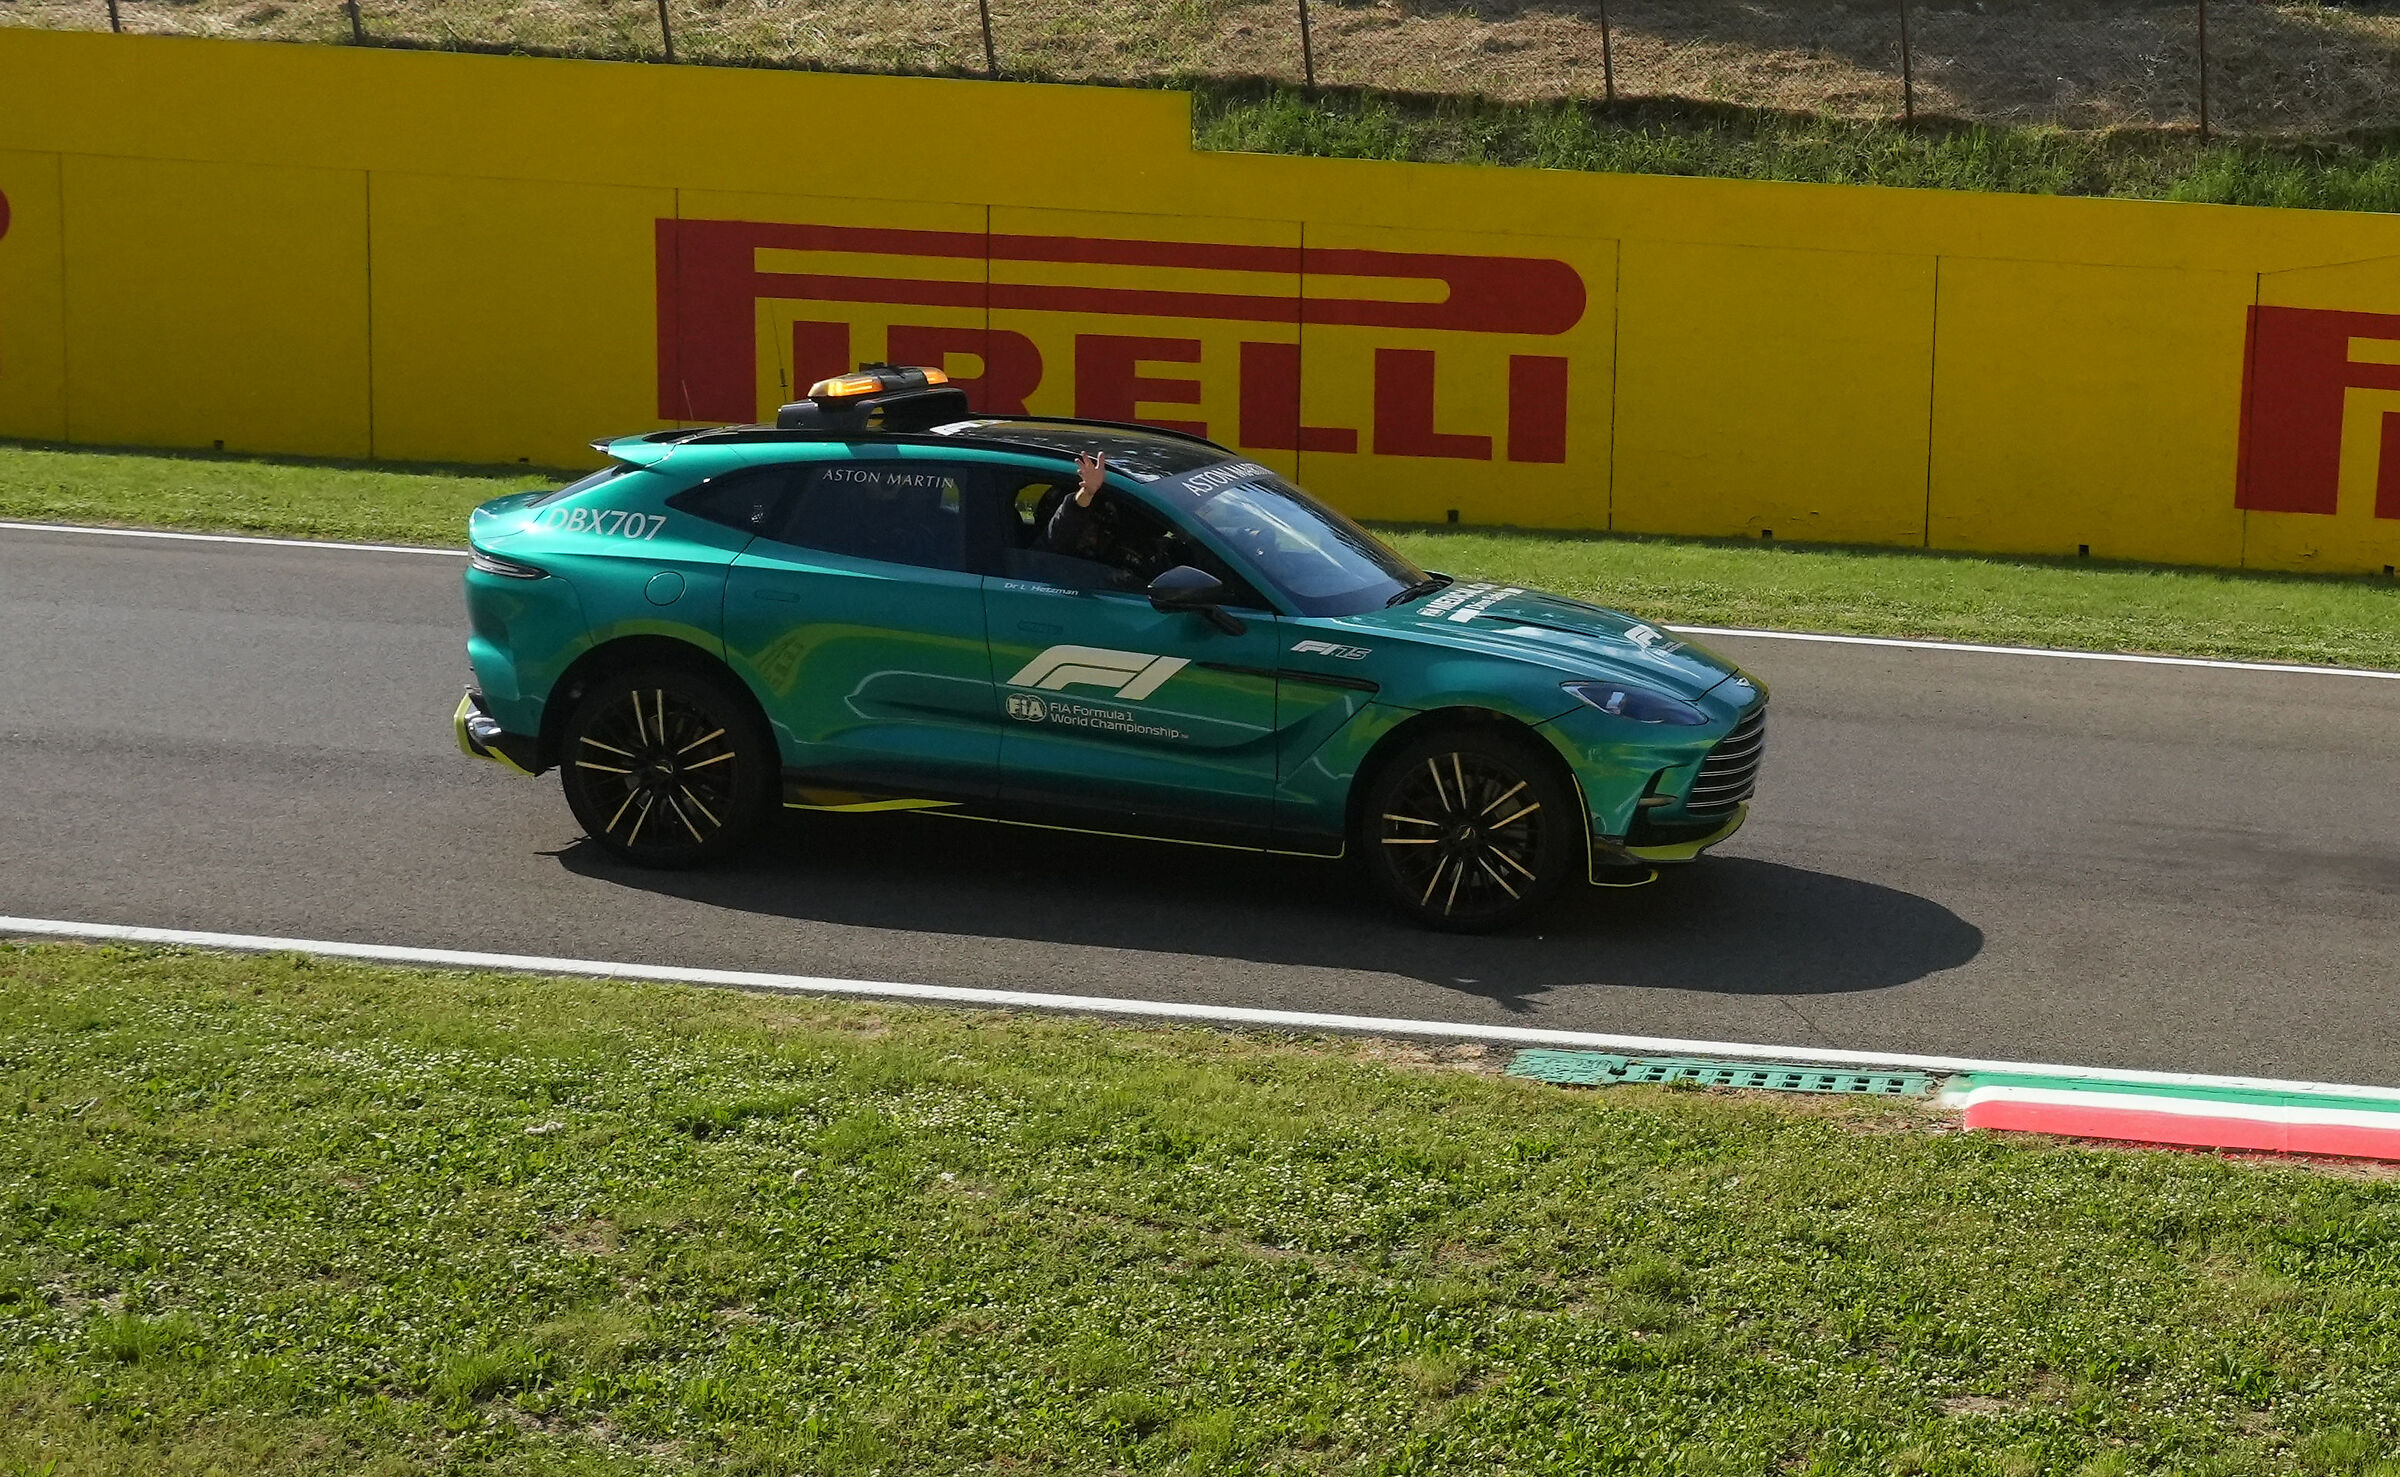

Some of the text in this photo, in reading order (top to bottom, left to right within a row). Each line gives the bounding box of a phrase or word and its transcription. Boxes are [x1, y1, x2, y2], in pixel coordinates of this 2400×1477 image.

[656, 218, 1587, 463] PIRELLI
[823, 469, 954, 488] ASTON MARTIN
[1181, 467, 1238, 496] ASTON
[546, 507, 667, 541] DBX707
[1050, 703, 1134, 722] FIA Formula 1
[1050, 713, 1179, 739] World Championship
